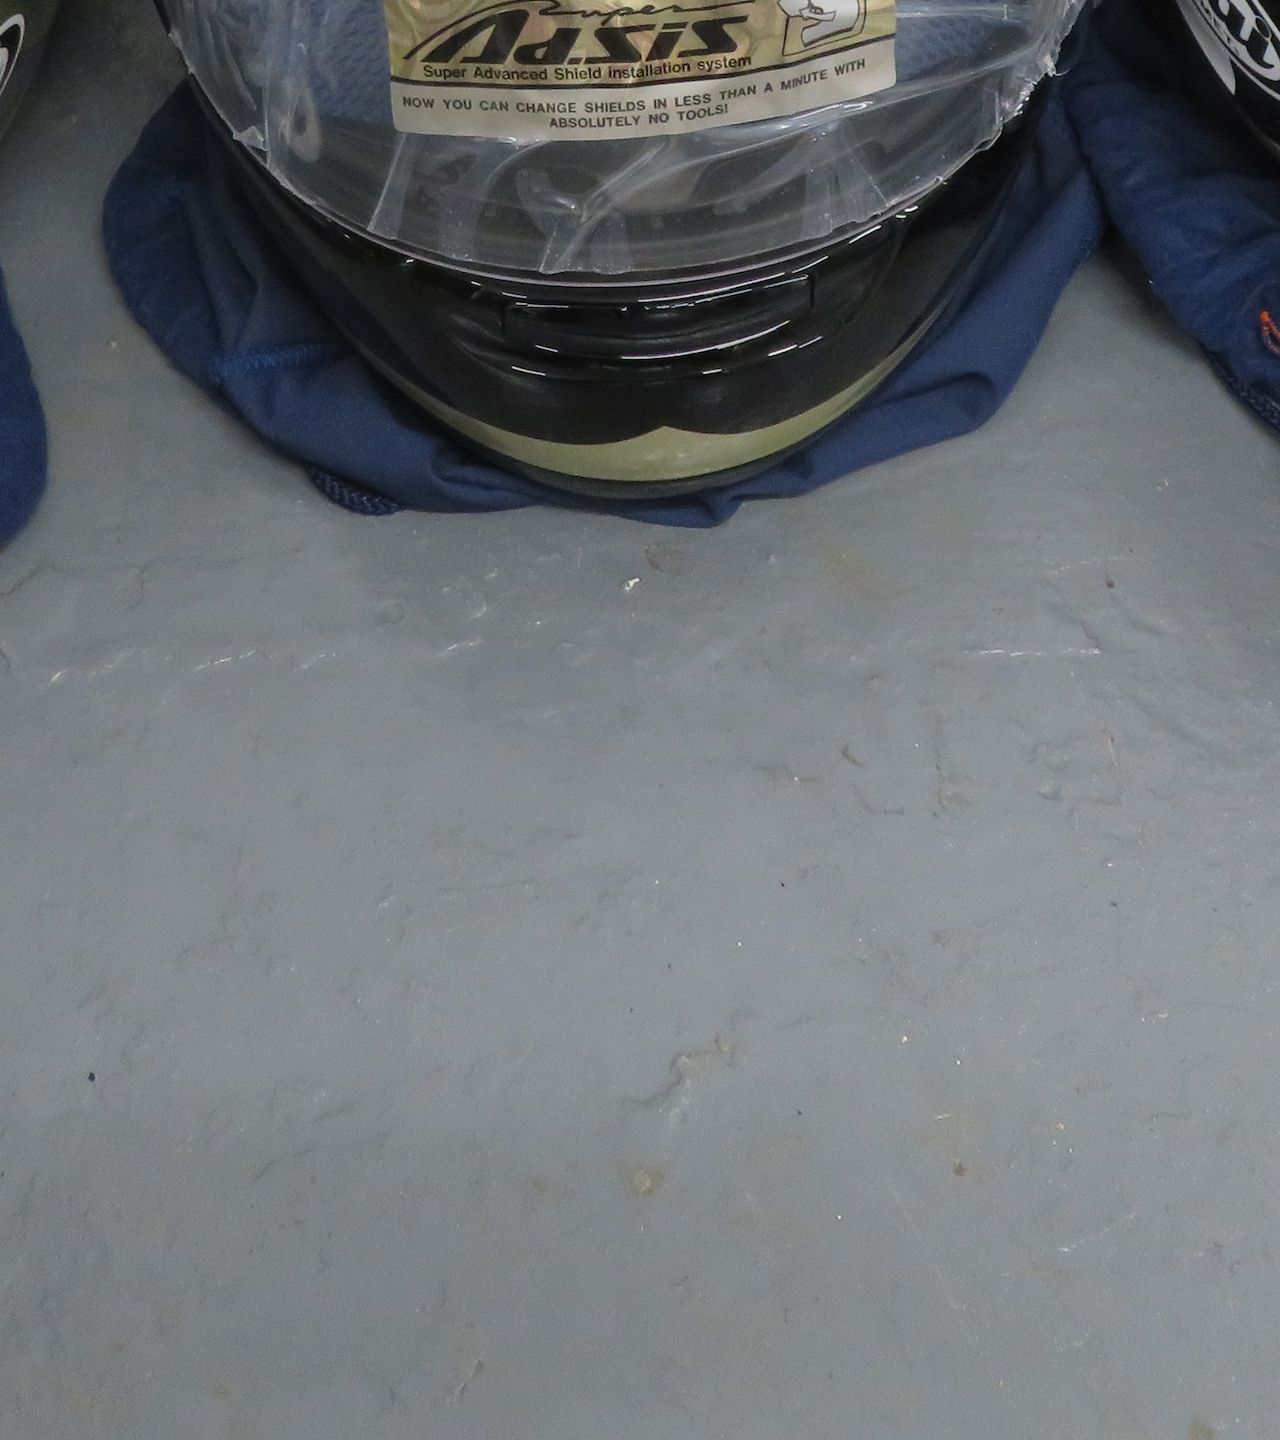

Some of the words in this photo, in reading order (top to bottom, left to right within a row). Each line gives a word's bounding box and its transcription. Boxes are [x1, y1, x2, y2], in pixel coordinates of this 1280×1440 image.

[423, 65, 467, 80] Super
[473, 65, 548, 81] Advanced
[554, 64, 602, 80] Shield
[608, 61, 691, 79] installation
[698, 56, 752, 76] system
[402, 96, 434, 109] NOW
[443, 98, 472, 110] YOU
[479, 100, 509, 112] CAN
[516, 101, 577, 114] CHANGE
[584, 100, 646, 113] SHIELDS
[654, 98, 668, 109] IN
[674, 93, 712, 108] LESS
[720, 85, 757, 100] THAN
[763, 82, 773, 92] A
[781, 71, 828, 91] MINUTE
[834, 59, 866, 77] WITH
[549, 115, 640, 129] ABSOLUTELY
[649, 112, 669, 124] NO
[679, 103, 728, 121] TOOLS!
